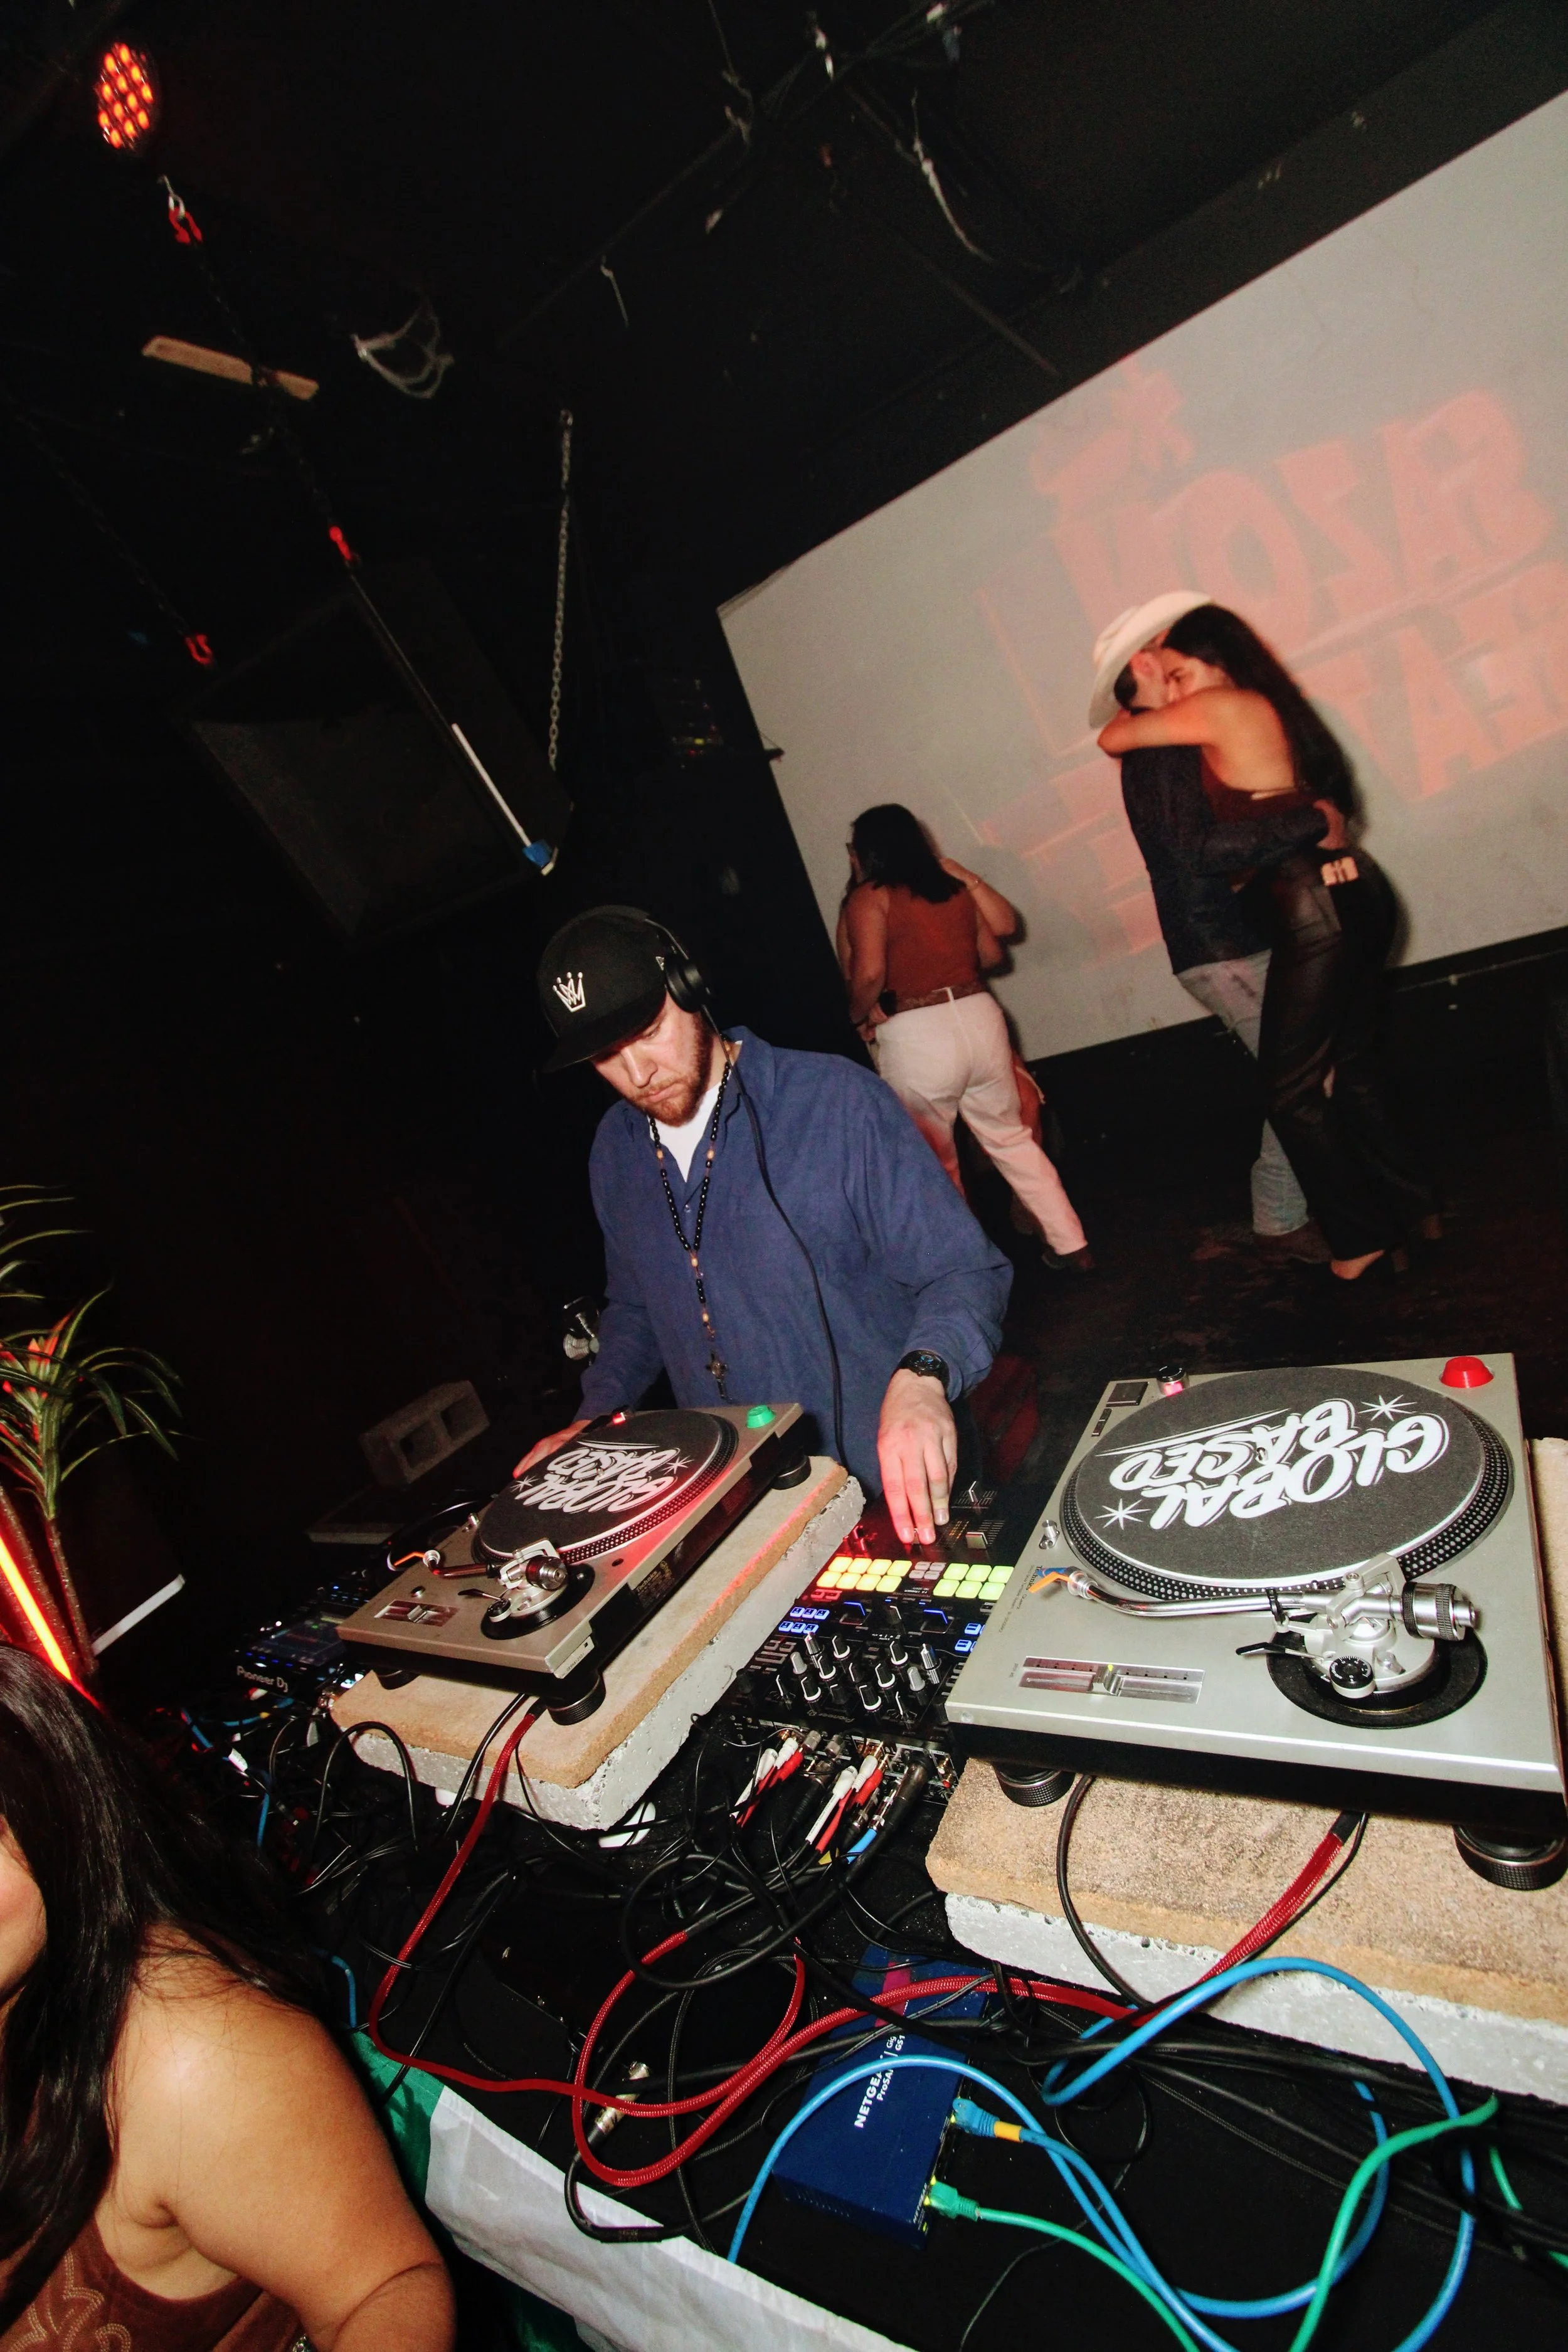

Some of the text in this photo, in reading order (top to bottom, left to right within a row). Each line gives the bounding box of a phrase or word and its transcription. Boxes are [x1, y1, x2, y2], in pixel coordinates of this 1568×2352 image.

[546, 1446, 681, 1481] BASED
[1108, 1398, 1357, 1491] BASED
[1142, 1412, 1449, 1530] GLOBAL
[237, 1665, 274, 1685] Pioneer
